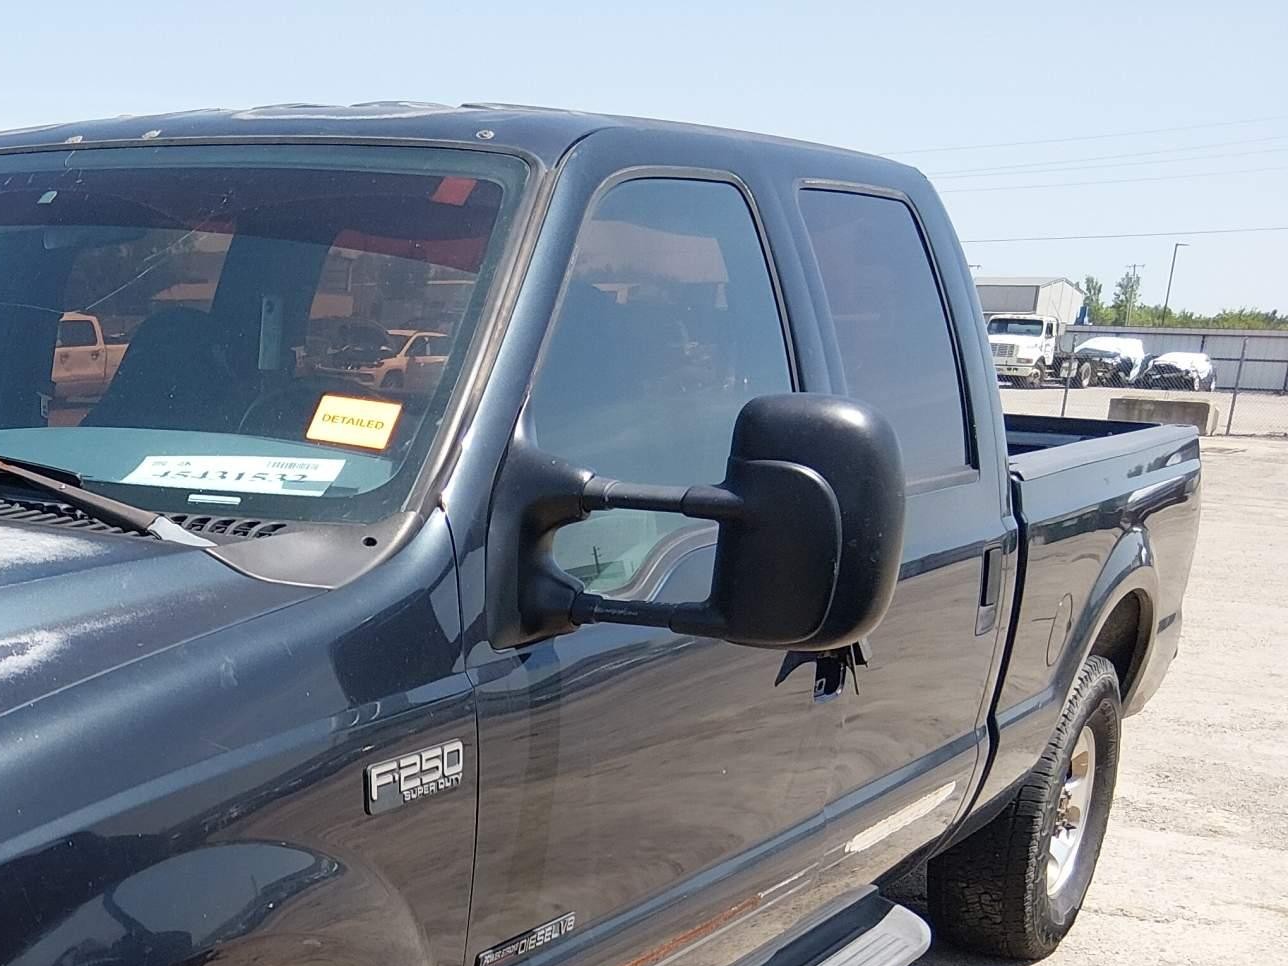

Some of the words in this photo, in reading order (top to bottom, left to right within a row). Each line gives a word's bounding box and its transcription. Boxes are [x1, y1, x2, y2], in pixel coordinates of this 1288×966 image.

[322, 413, 385, 432] DETAILED
[403, 783, 437, 801] SUPER
[438, 772, 464, 791] DUTY
[518, 925, 561, 956] DIESEL
[560, 914, 576, 936] V8
